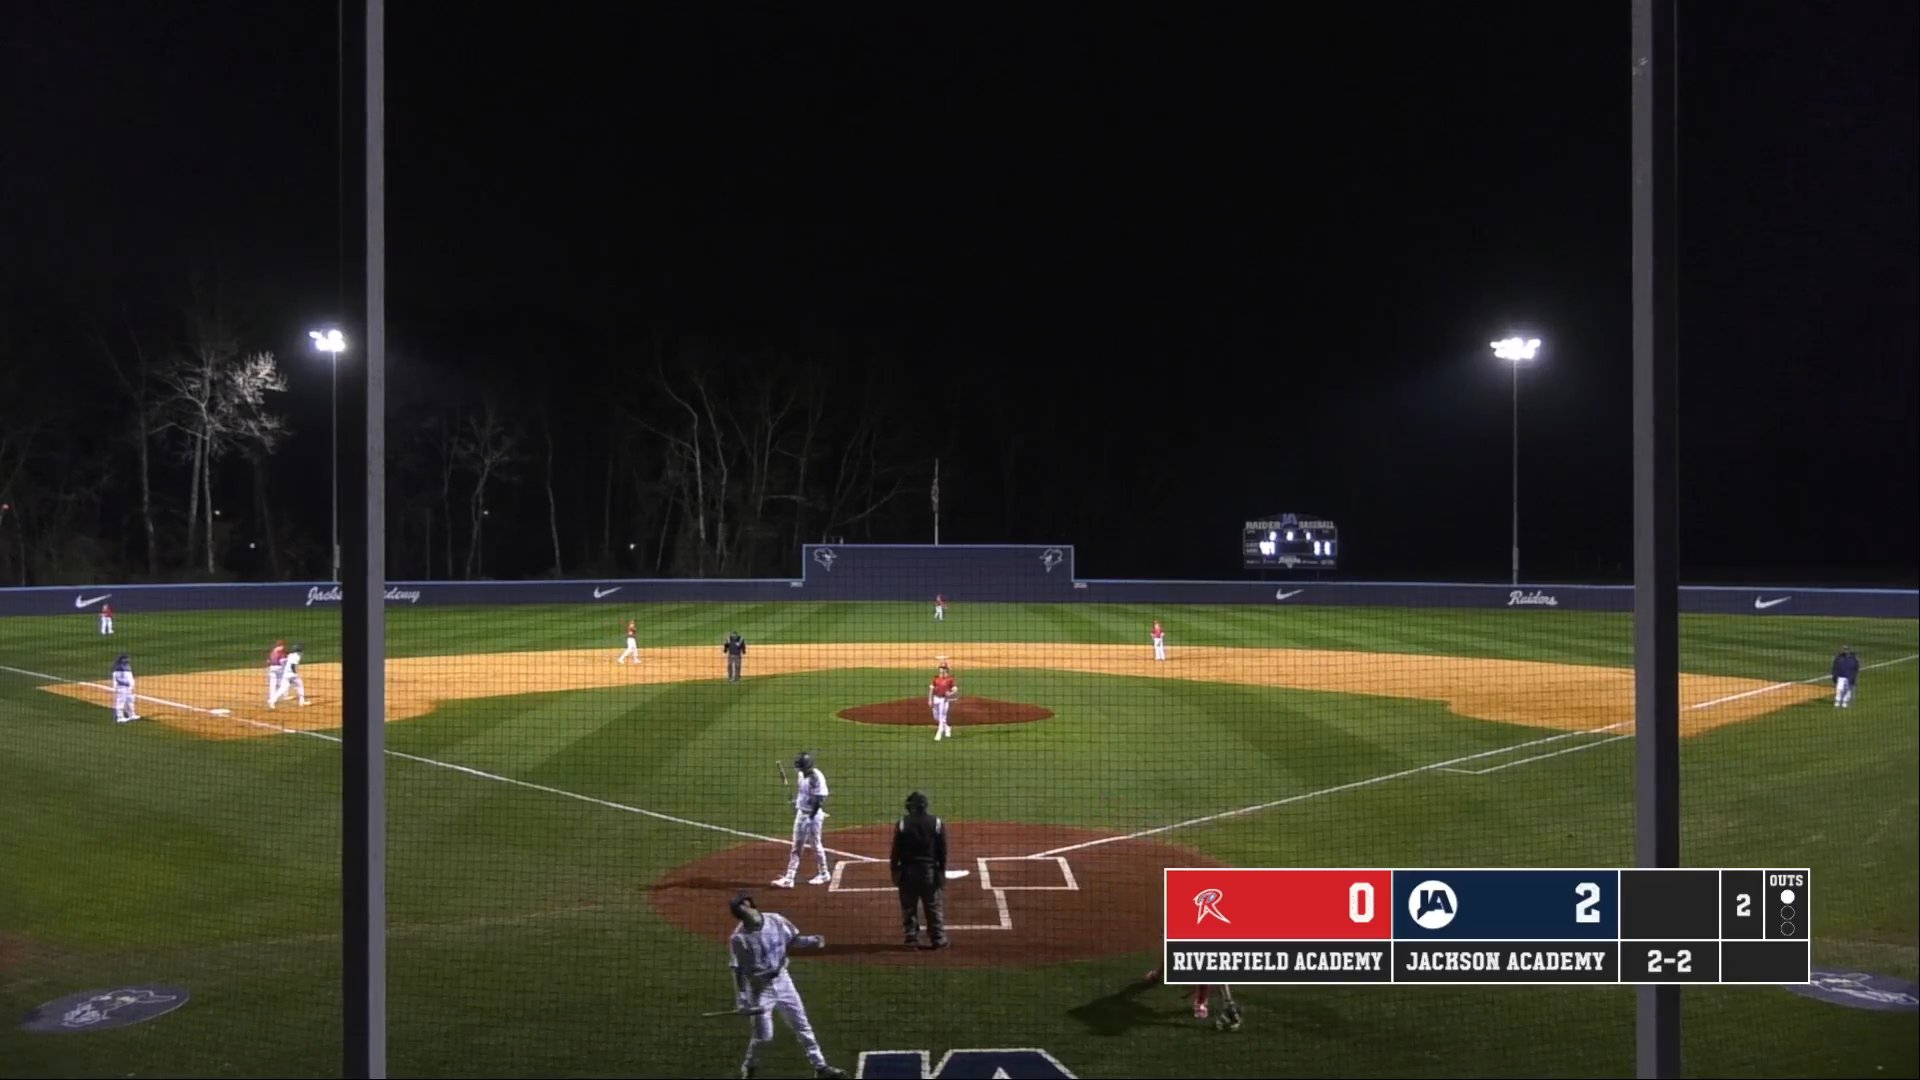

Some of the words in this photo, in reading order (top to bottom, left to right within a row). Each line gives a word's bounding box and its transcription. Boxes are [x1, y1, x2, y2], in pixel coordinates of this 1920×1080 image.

[1246, 521, 1280, 529] RAIDER
[1299, 521, 1334, 529] BASEBALL
[1508, 590, 1558, 605] Raiders
